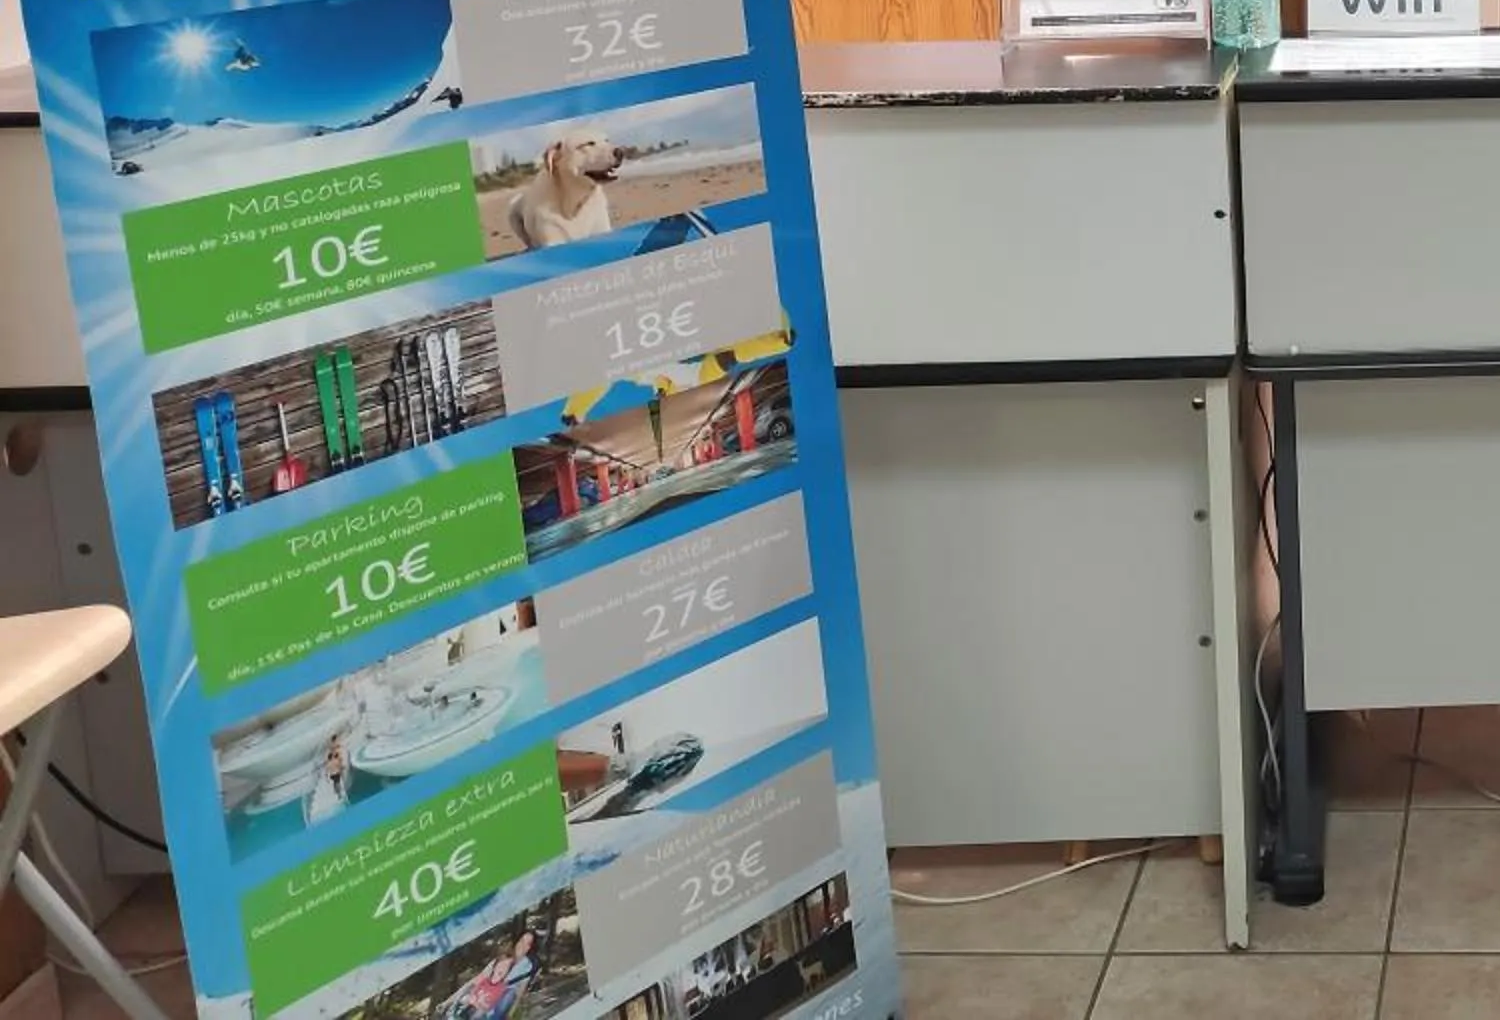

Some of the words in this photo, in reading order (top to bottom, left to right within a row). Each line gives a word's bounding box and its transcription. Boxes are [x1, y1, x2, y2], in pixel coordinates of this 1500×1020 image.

[564, 13, 663, 63] 32€
[146, 244, 197, 263] Menos
[199, 236, 217, 252] de
[222, 229, 256, 248] 25kg
[270, 221, 289, 234] no
[402, 180, 462, 207] peligrosa
[226, 170, 383, 221] Mascotas
[255, 298, 284, 317] 50€
[375, 259, 437, 286] quincena
[272, 224, 390, 290] 10€
[605, 300, 699, 360] 18€
[286, 495, 424, 557] Parking
[304, 533, 387, 575] apartamento
[325, 542, 437, 619] 10€
[641, 576, 735, 644] 27€
[287, 809, 435, 897] Limpieza
[445, 770, 517, 819] extra
[371, 838, 481, 919] 40€
[679, 839, 767, 917] 28€
